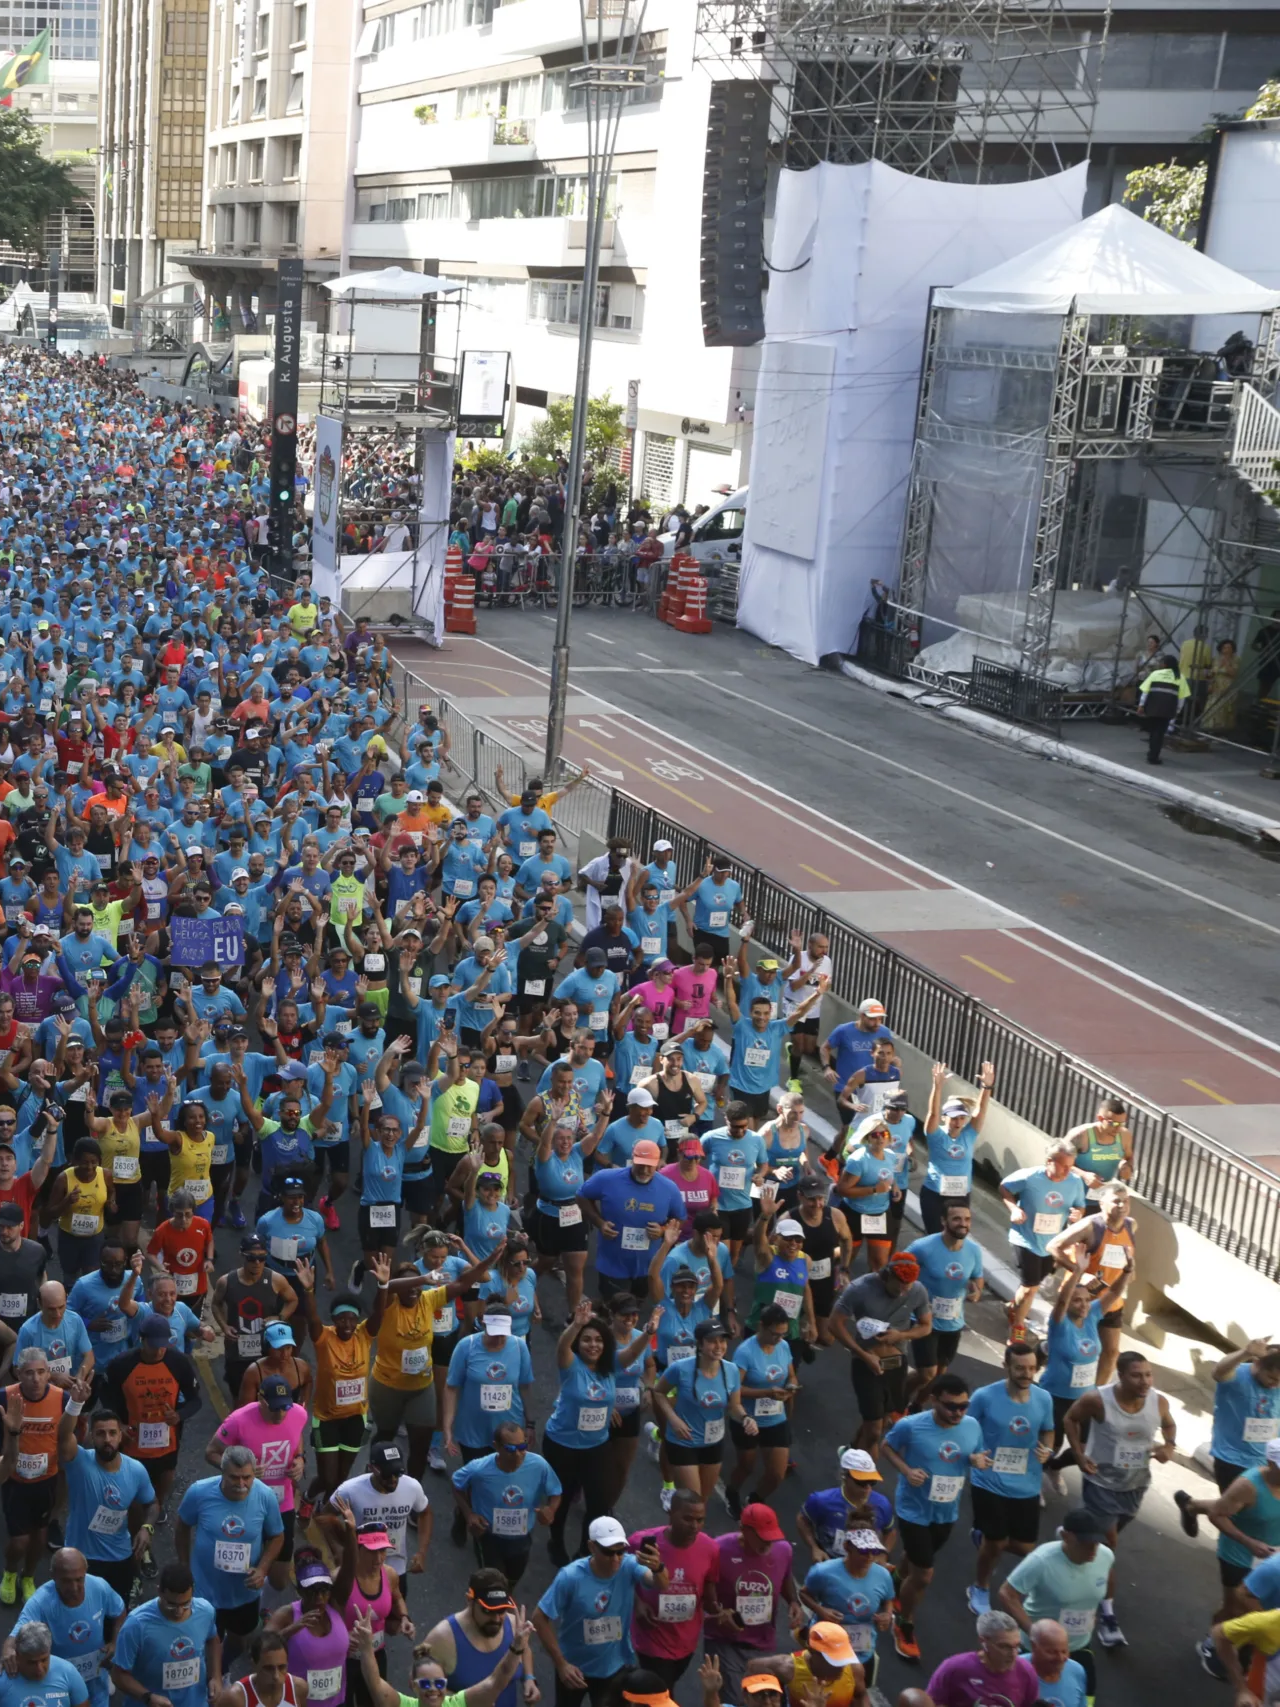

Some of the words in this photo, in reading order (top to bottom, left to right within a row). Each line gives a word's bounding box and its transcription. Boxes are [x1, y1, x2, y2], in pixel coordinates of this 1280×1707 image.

[280, 300, 295, 364] Augusta
[281, 369, 290, 382] R.
[214, 937, 238, 962] EU
[114, 1162, 136, 1171] 26365
[687, 1190, 709, 1200] ELITE
[372, 1211, 391, 1219] 12945
[73, 1220, 93, 1229] 24496
[1, 1300, 20, 1309] 3398
[340, 1385, 359, 1395] 1842
[483, 1392, 506, 1400] 11428
[581, 1414, 605, 1422] 12303
[143, 1430, 162, 1439] 9181
[363, 1508, 377, 1516] EU
[381, 1505, 410, 1514] PAGO
[496, 1516, 521, 1526] 15861
[217, 1549, 244, 1561] 16370
[739, 1582, 769, 1592] FUZZY
[664, 1603, 687, 1613] 5346
[78, 1661, 93, 1672] 259
[165, 1666, 193, 1679] 18702
[312, 1678, 333, 1689] 9601
